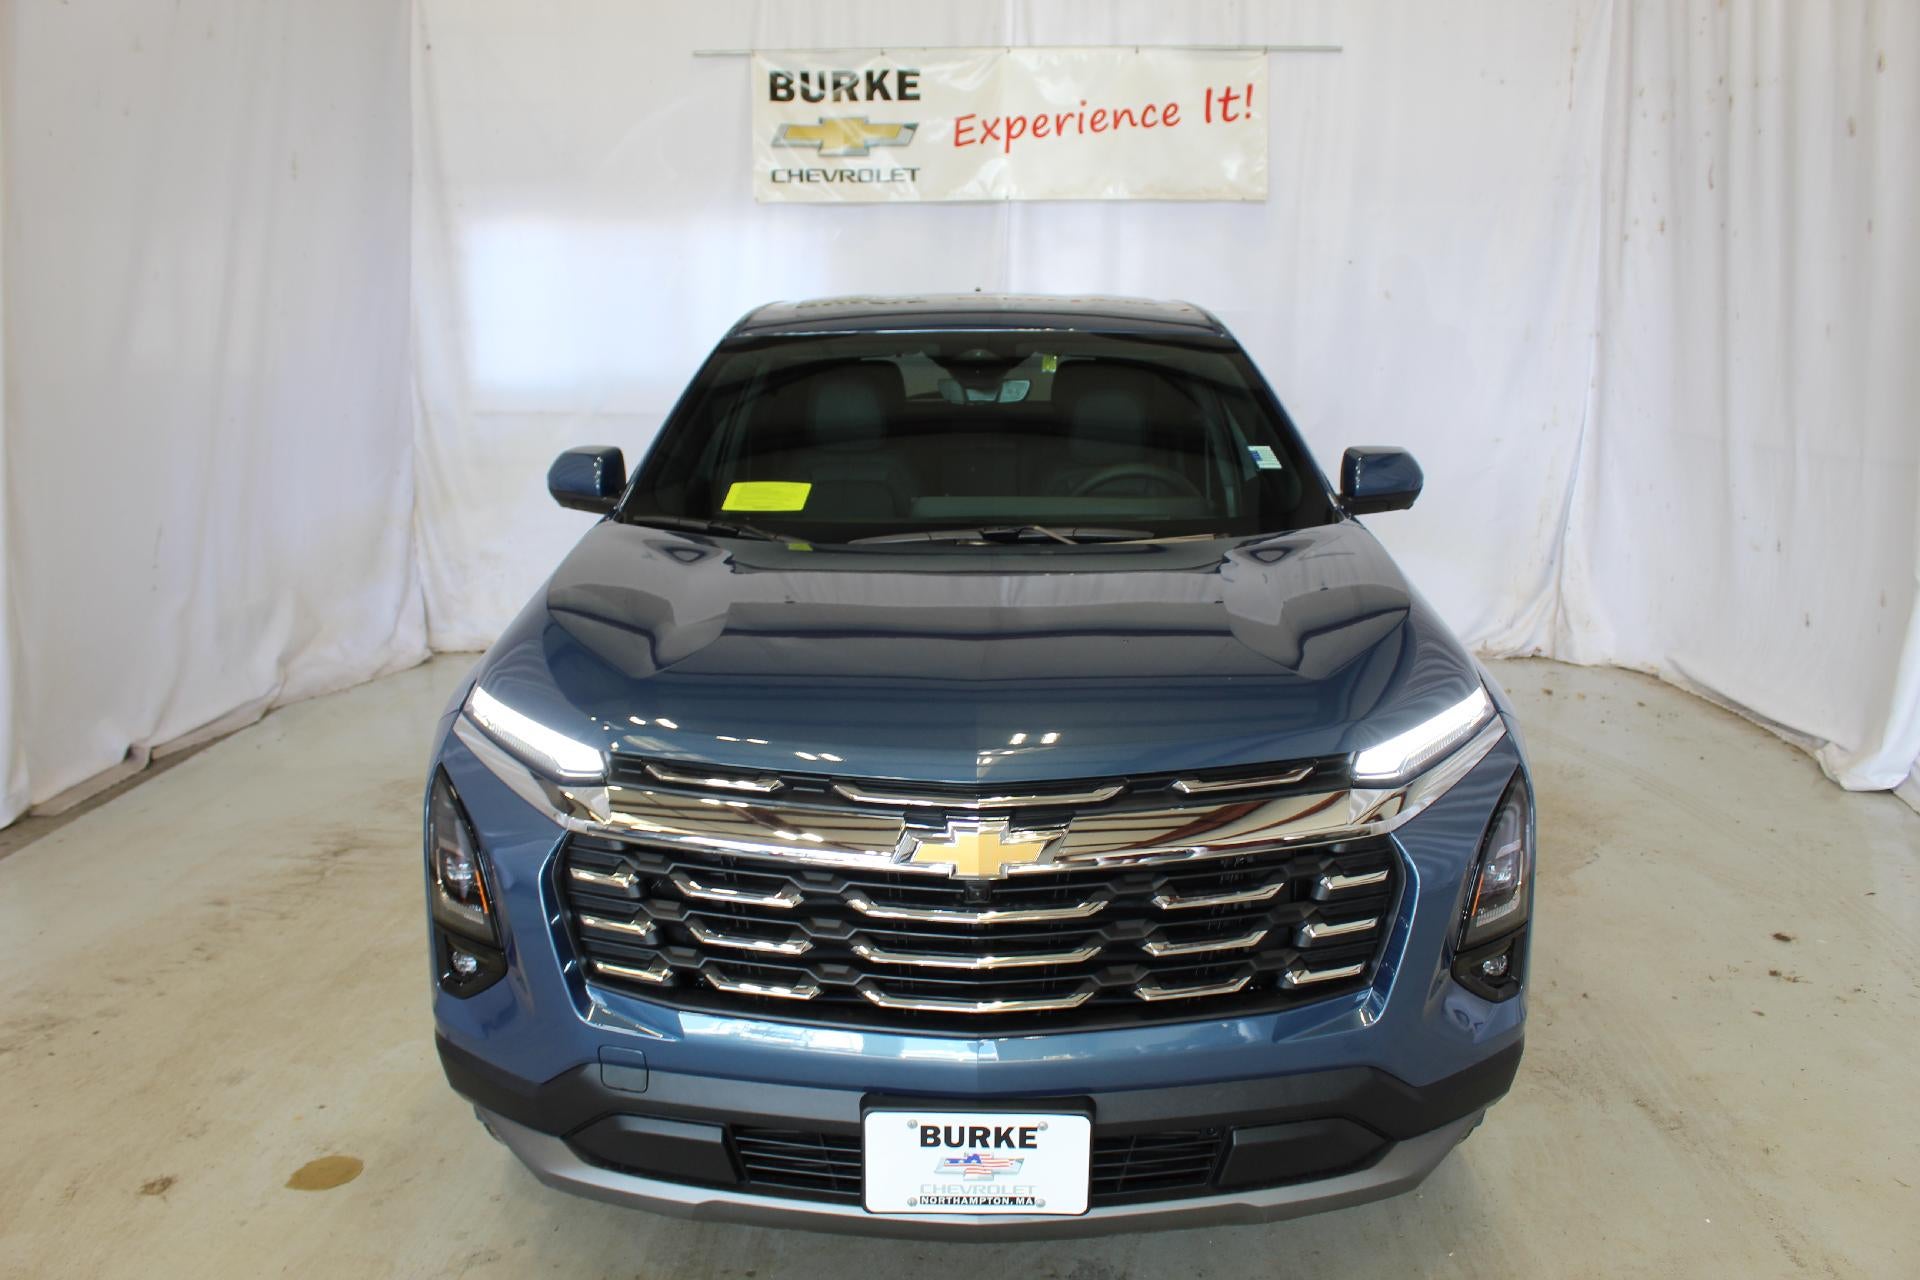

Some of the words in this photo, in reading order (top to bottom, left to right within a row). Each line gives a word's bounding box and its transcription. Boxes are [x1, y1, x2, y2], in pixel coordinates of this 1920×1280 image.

[769, 69, 920, 102] BURKE
[953, 101, 1180, 153] Experience
[1204, 83, 1254, 124] It!
[770, 167, 920, 184] CHEVROLET
[920, 1125, 1038, 1149] BURKE
[920, 1184, 1037, 1195] CHEVROLET
[1015, 1197, 1034, 1206] MA
